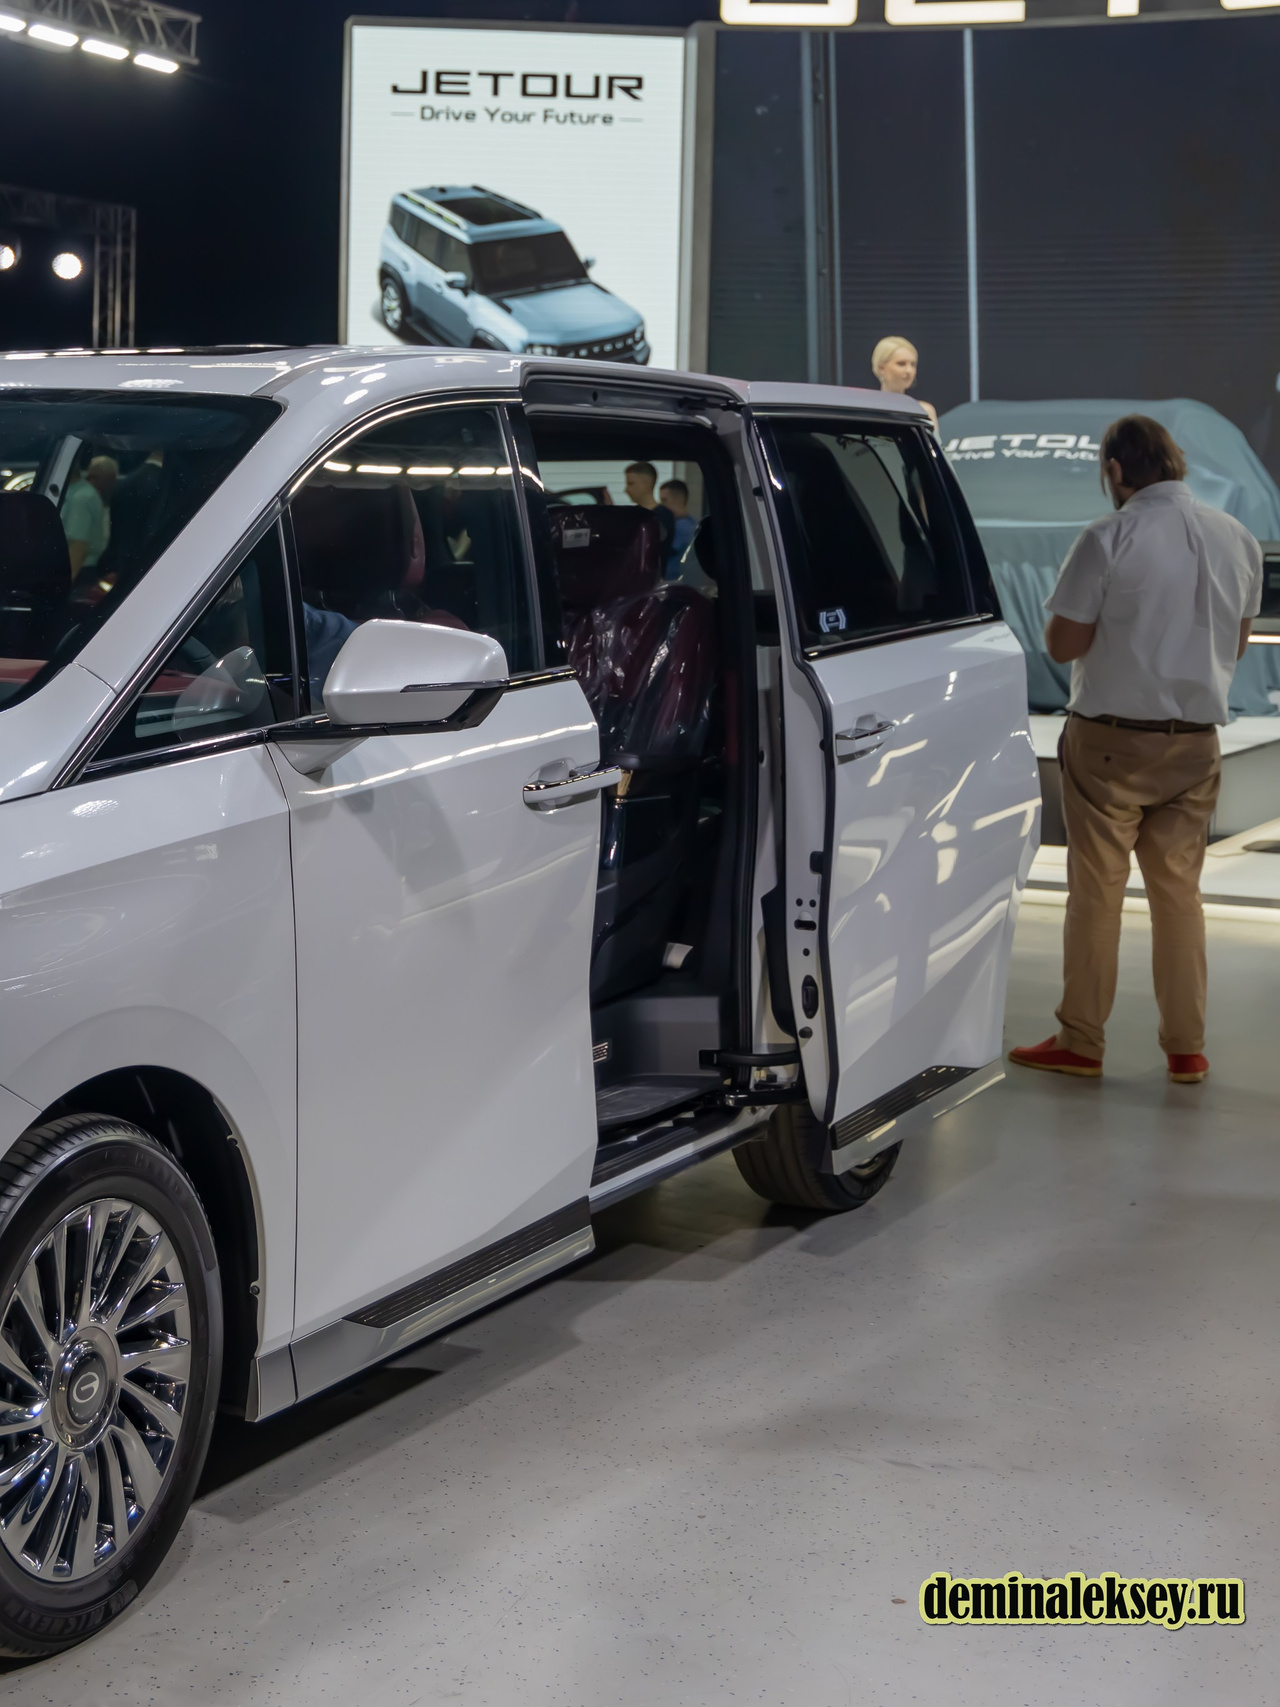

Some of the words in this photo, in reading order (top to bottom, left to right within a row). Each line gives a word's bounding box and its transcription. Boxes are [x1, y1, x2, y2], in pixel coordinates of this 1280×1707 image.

[391, 70, 643, 101] JETOUR
[420, 105, 477, 122] Drive
[484, 107, 536, 124] Your
[543, 108, 615, 126] Future
[944, 434, 1101, 451] JETOU
[1053, 449, 1100, 461] Futu
